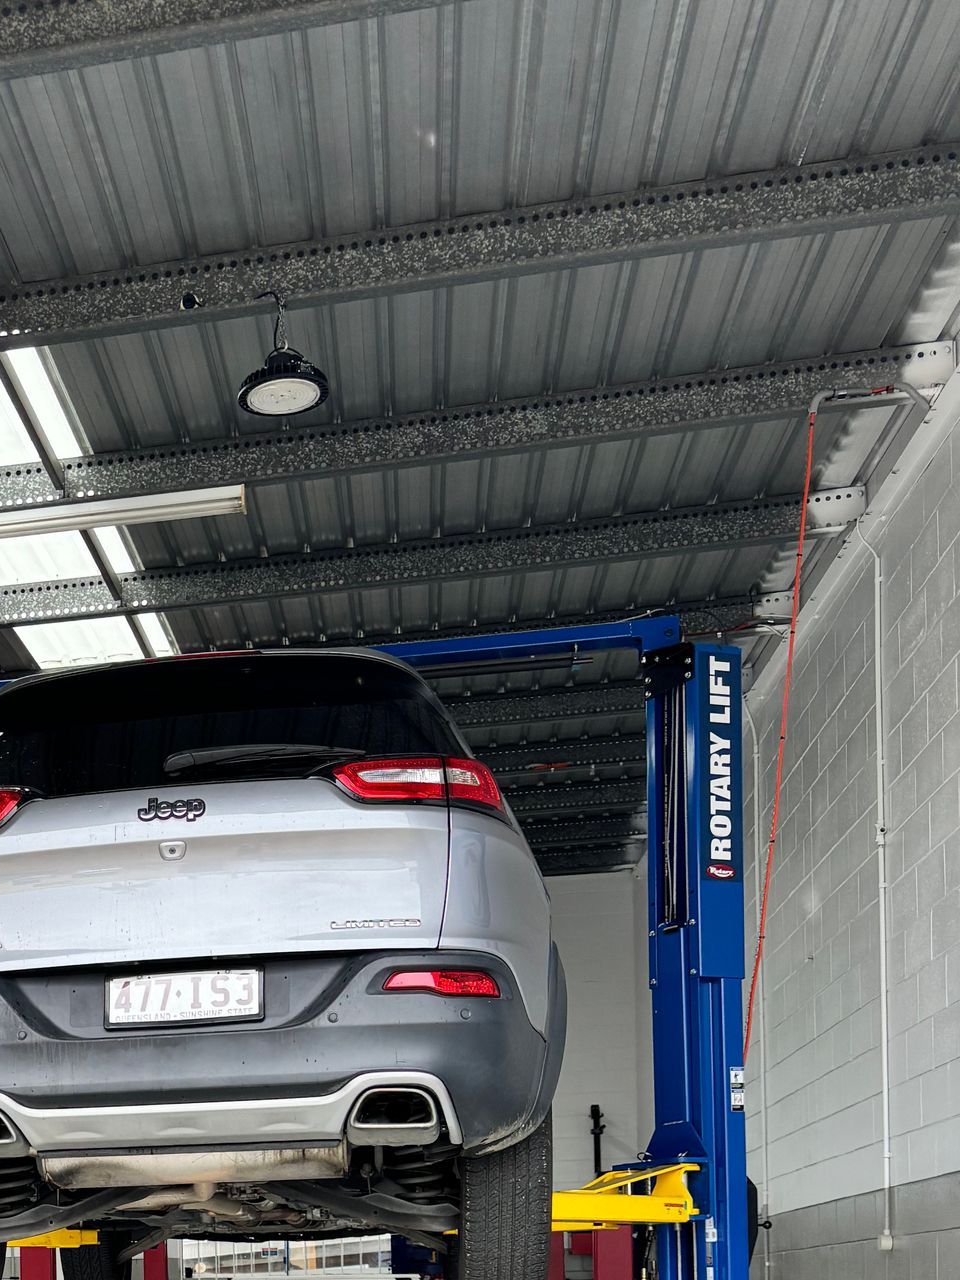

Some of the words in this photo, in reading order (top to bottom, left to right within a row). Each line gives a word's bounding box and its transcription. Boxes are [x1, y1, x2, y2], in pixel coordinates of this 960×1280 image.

[709, 656, 731, 724] LIFT
[137, 797, 206, 822] Jeep
[710, 732, 732, 861] ROTARY
[331, 919, 421, 929] LIMITED
